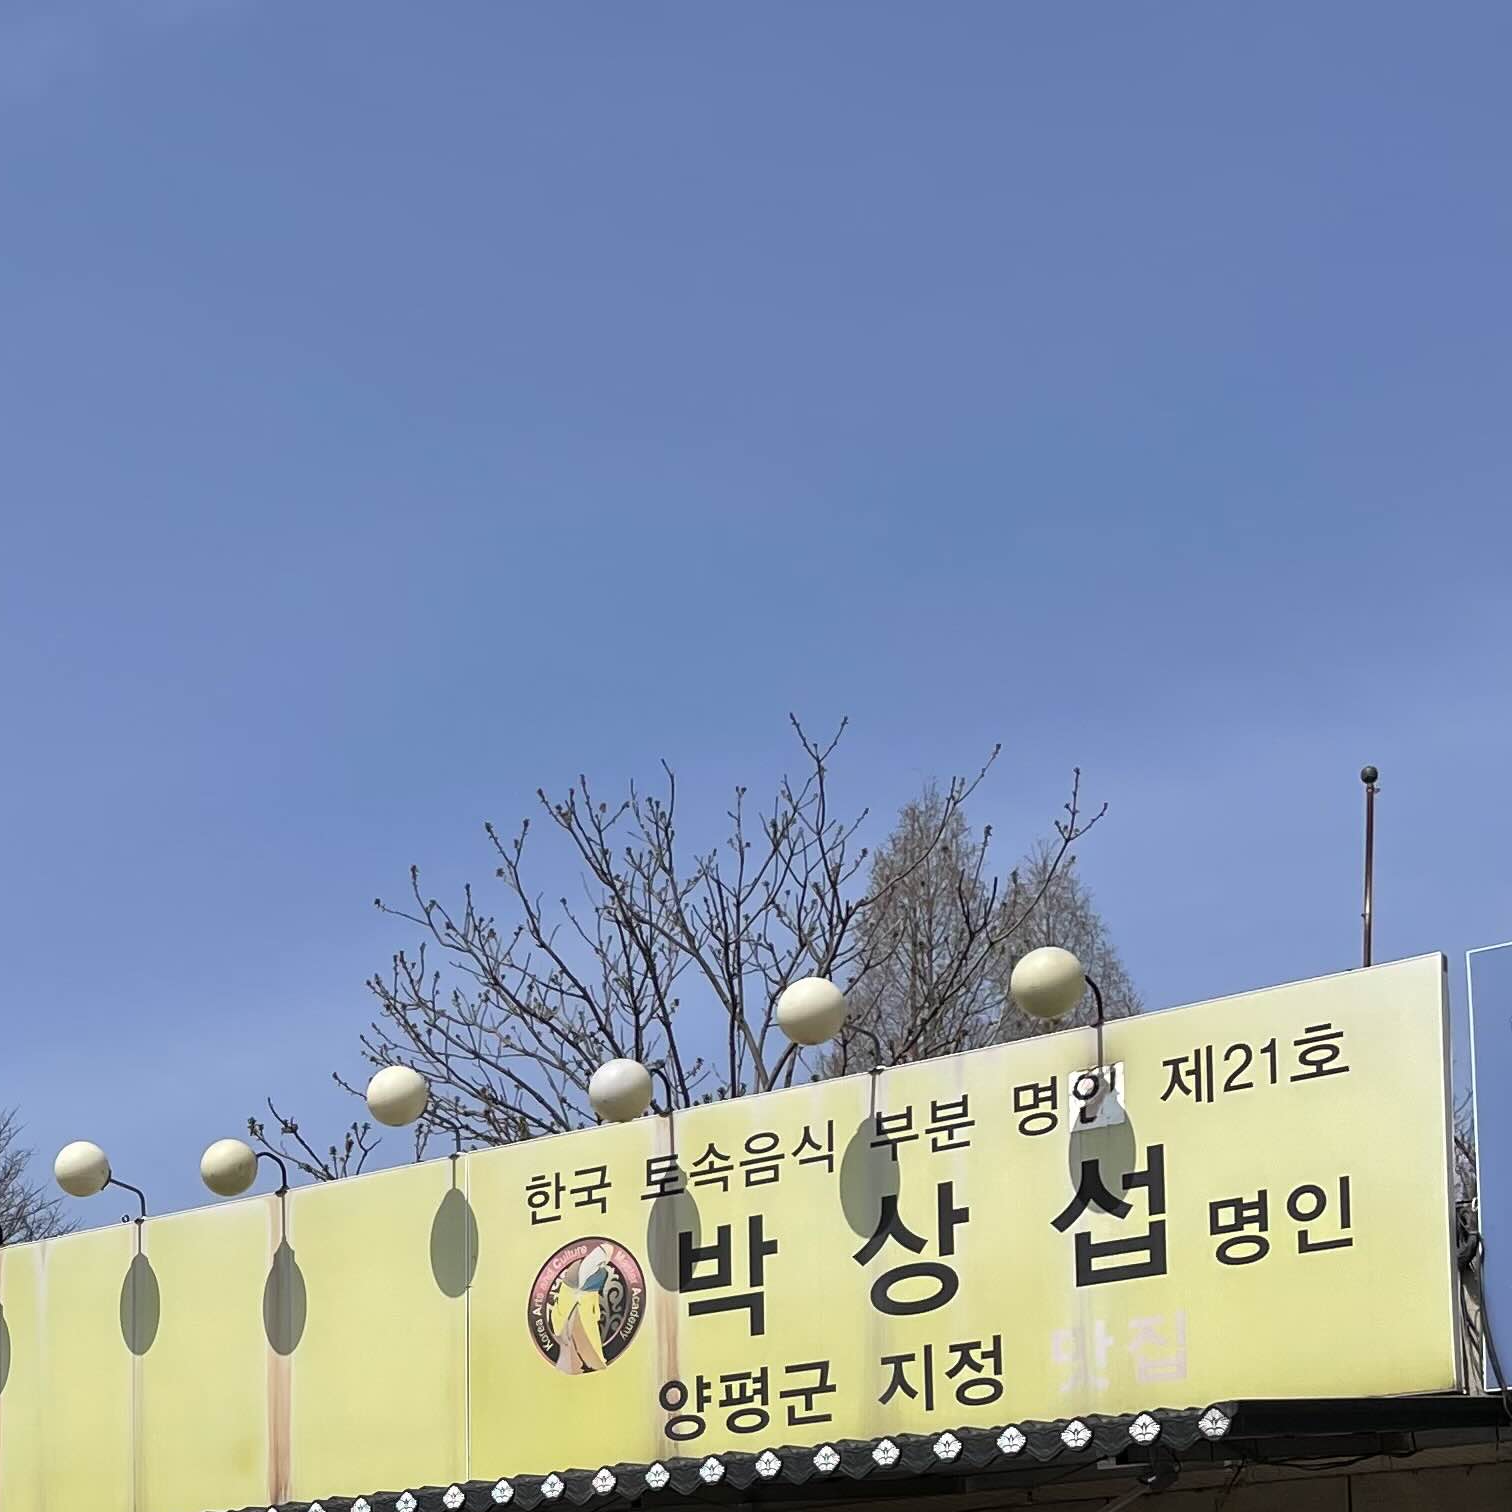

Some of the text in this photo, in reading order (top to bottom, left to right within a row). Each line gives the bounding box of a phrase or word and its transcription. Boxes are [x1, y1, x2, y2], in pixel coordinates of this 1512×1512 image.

[525, 1022, 1351, 1226] 한국 토속음식 부분 명인 제21호
[677, 1142, 1354, 1338] 박 상 섭 명인
[535, 1319, 554, 1351] Korea
[621, 1287, 642, 1340] Academy
[657, 1359, 838, 1442] 양평군
[877, 1333, 1005, 1412] 지정
